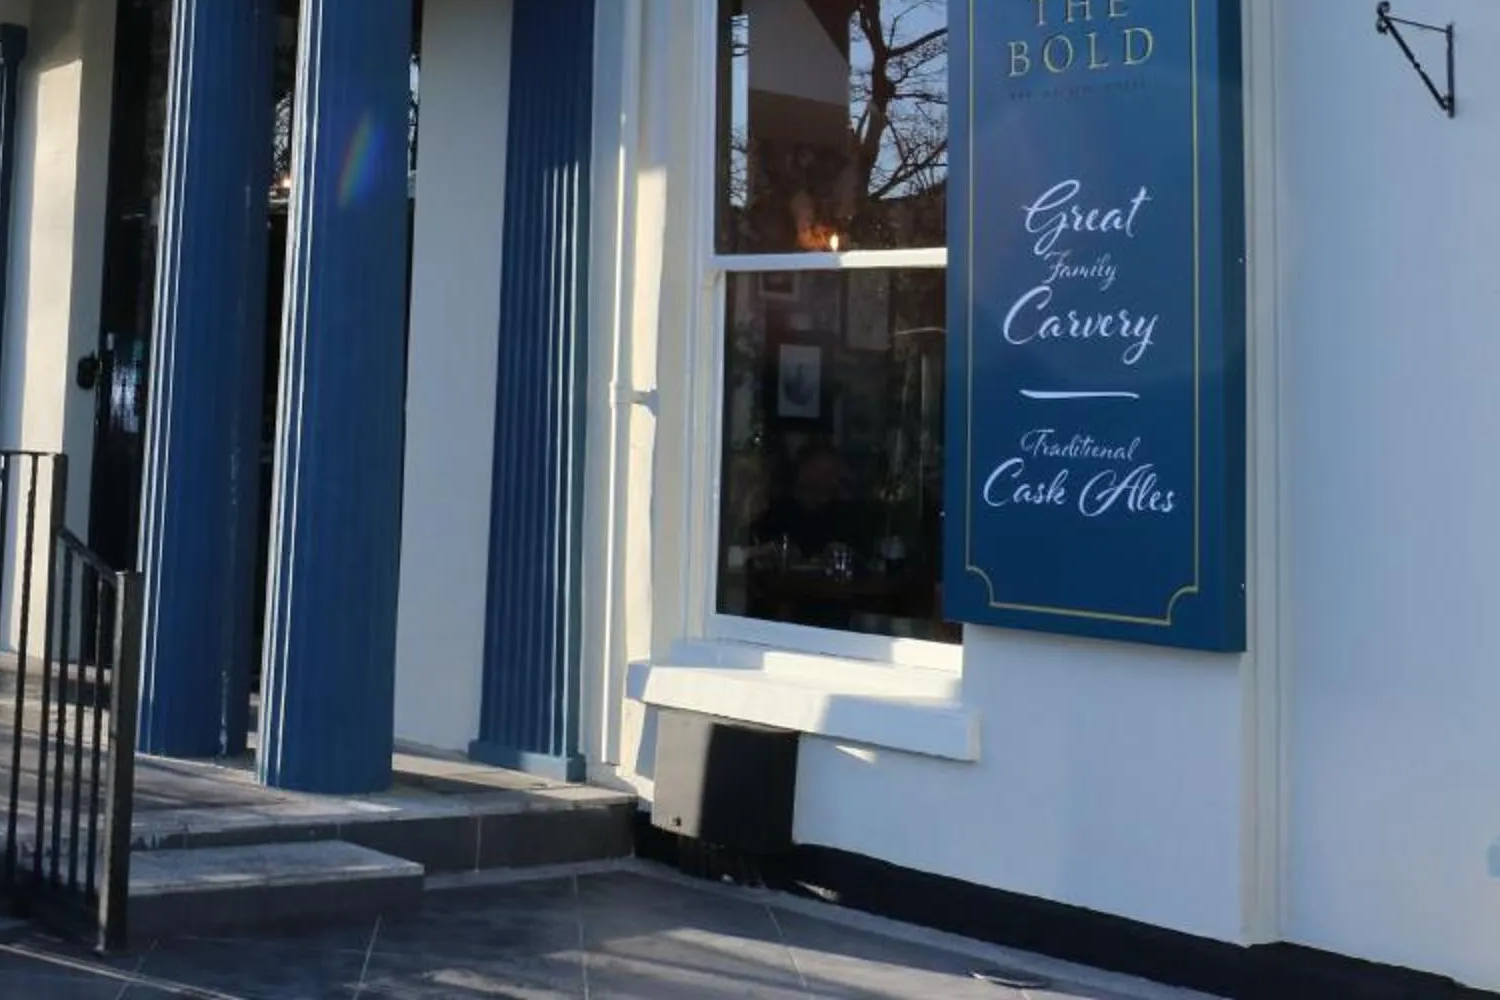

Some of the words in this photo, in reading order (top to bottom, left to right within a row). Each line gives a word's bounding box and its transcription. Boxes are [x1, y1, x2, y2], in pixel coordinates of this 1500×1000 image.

[1007, 26, 1155, 78] BOLD
[1023, 178, 1153, 256] Great
[1040, 249, 1118, 292] Family
[1002, 285, 1160, 365] Carvery
[1019, 428, 1142, 461] Traditional
[983, 457, 1070, 507] Cask
[1078, 462, 1177, 517] Ales
